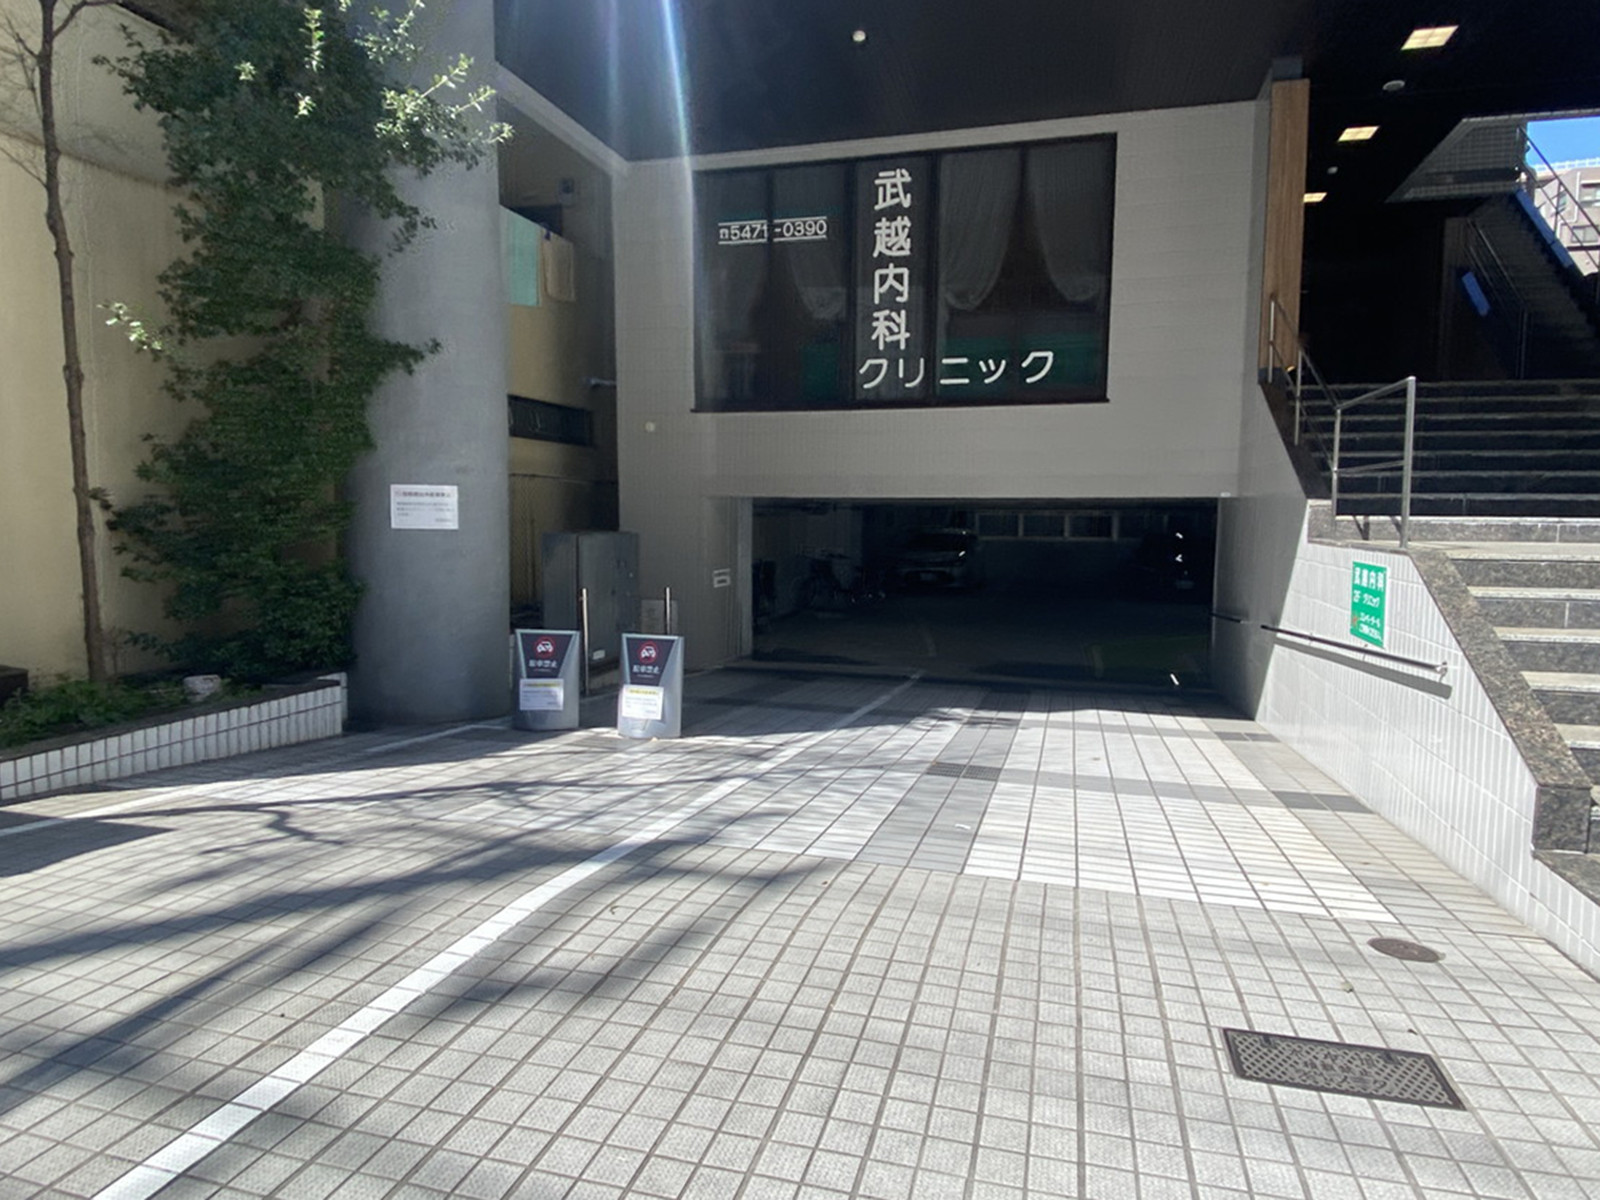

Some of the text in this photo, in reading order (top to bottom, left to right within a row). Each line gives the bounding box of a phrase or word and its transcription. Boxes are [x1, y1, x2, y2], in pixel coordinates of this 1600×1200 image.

[873, 168, 912, 351] 武越内科
[859, 351, 1054, 389] クリニック
